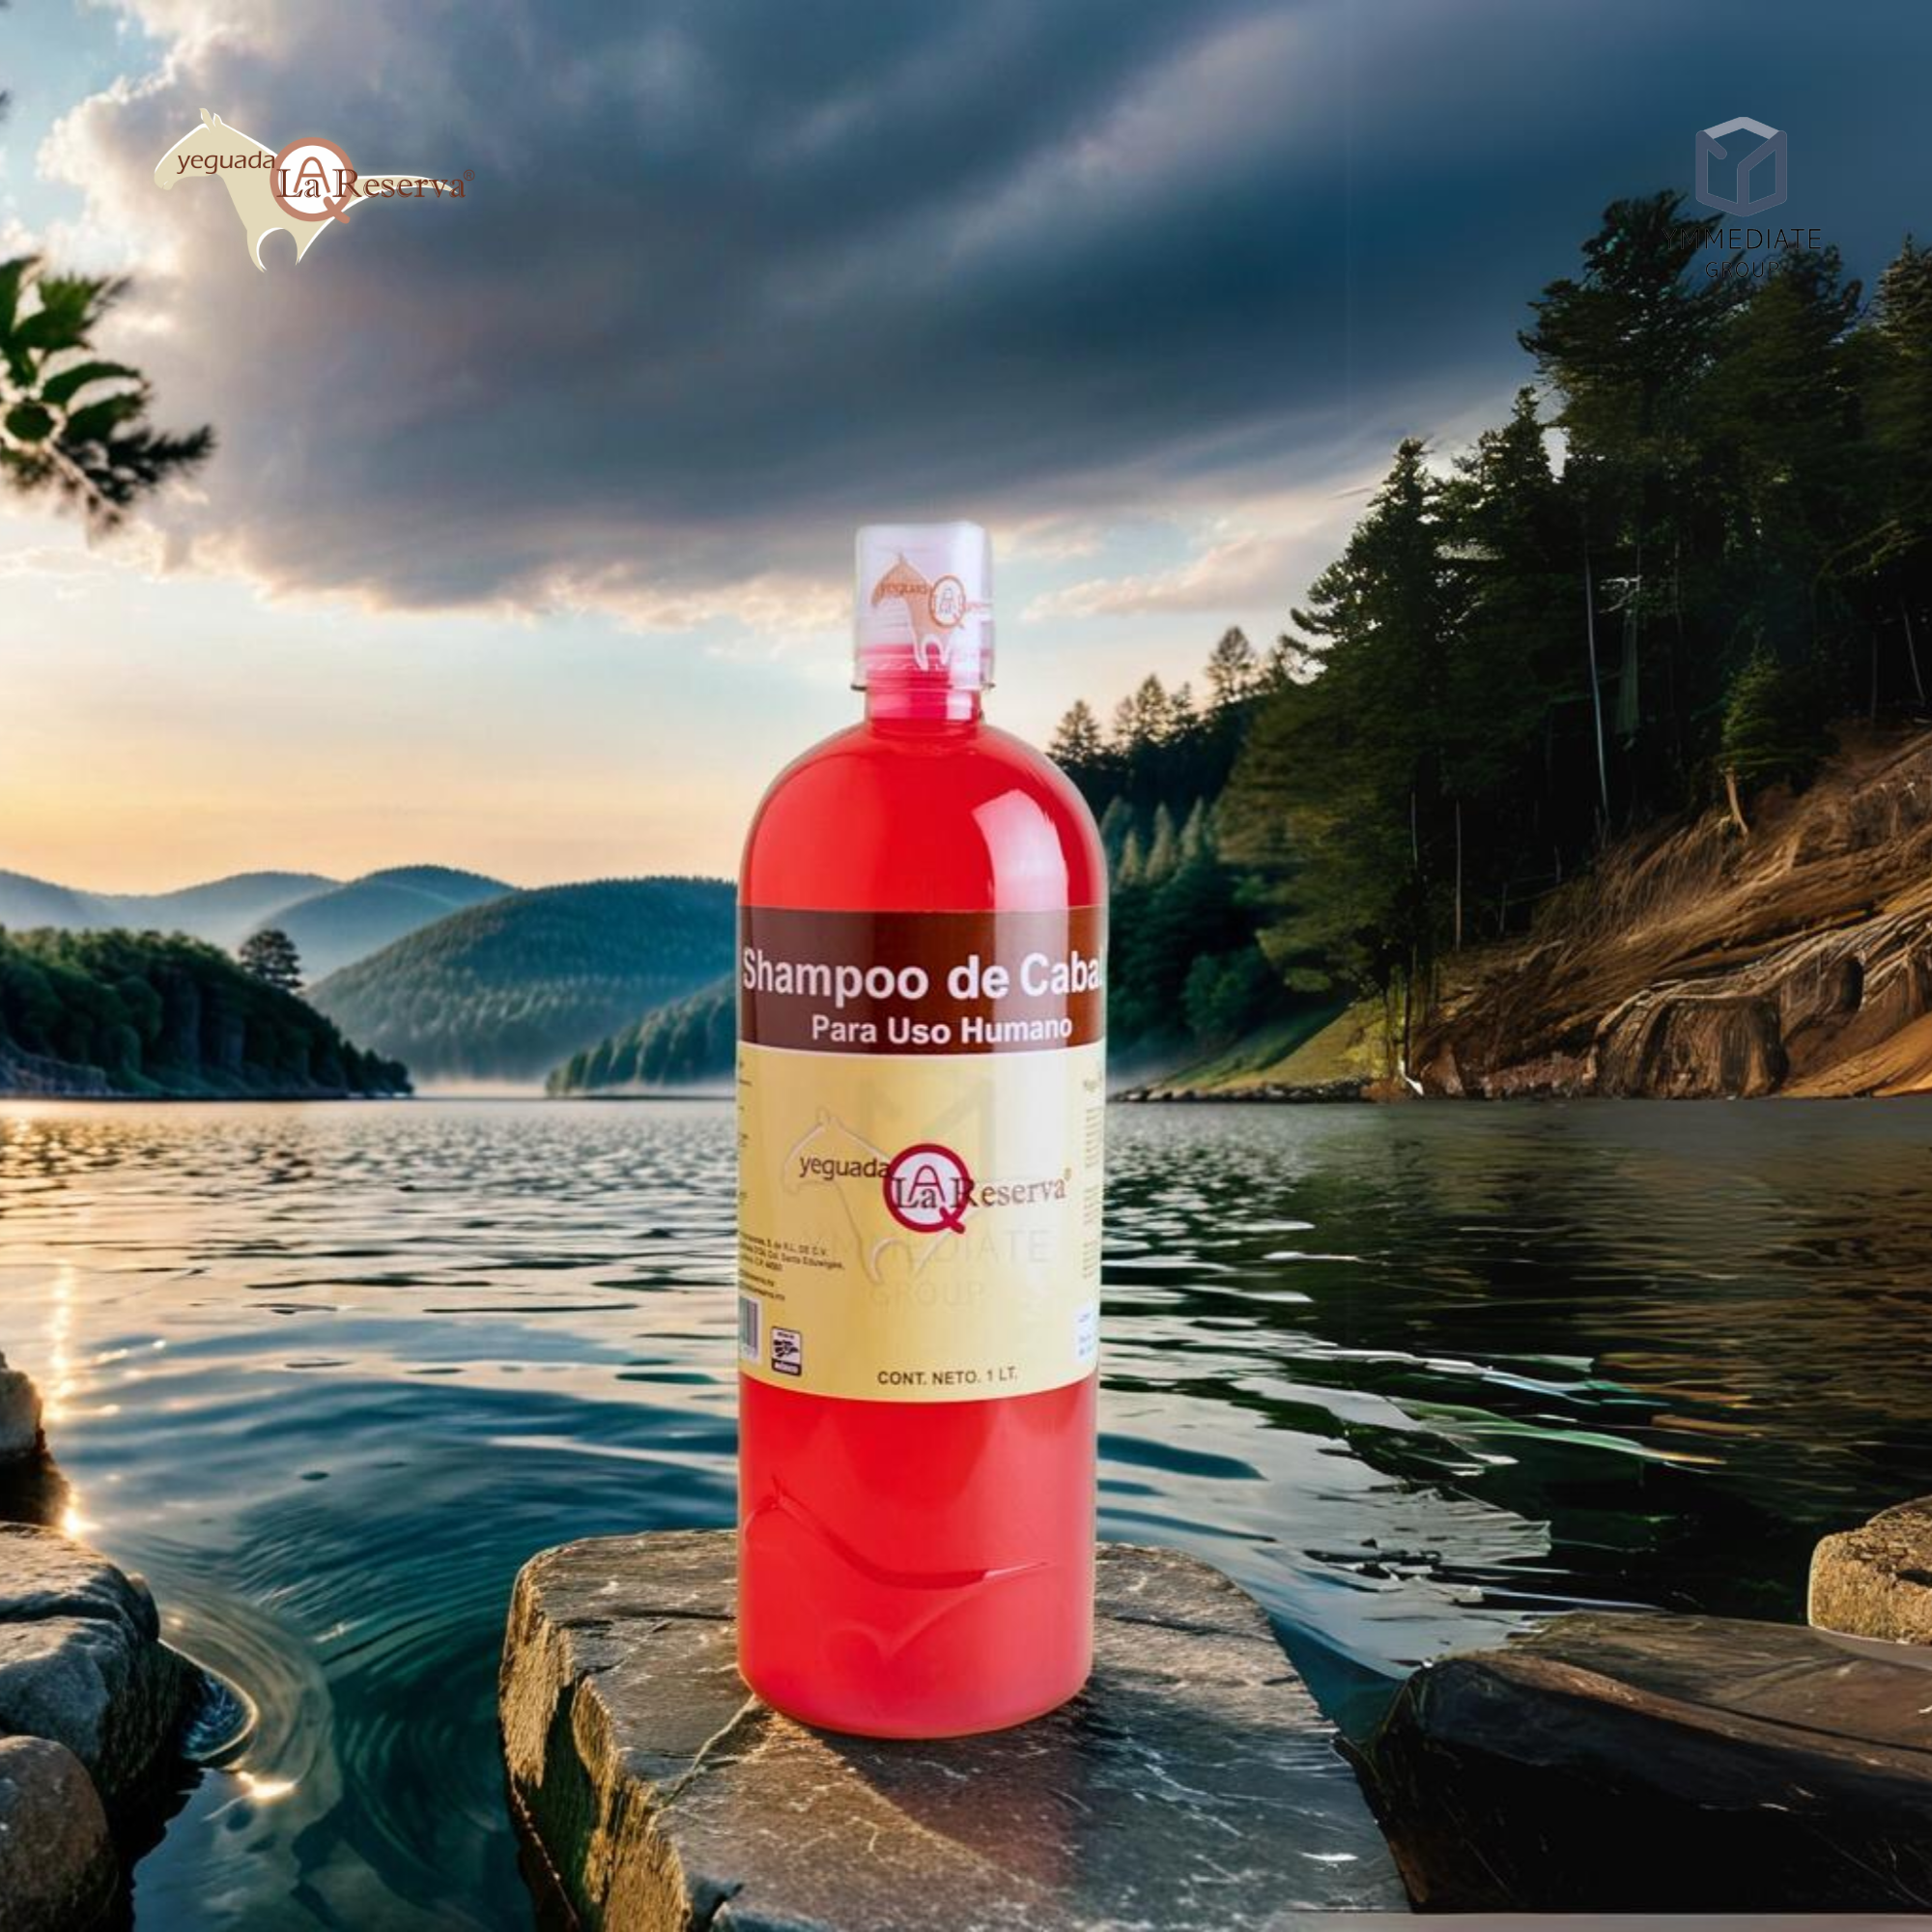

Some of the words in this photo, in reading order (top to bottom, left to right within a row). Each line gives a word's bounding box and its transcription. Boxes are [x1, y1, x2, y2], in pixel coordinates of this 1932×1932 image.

[742, 948, 929, 1009] Shampoo
[948, 954, 1009, 999] de
[811, 1014, 876, 1042] Para
[888, 1016, 952, 1044] Uso
[961, 1014, 1073, 1043] Humano
[800, 1156, 889, 1179] yeguada
[893, 1177, 938, 1208] La
[877, 1370, 927, 1386] CONT.
[932, 1370, 981, 1385] NETO.
[986, 1370, 994, 1382] 1
[999, 1366, 1018, 1381] LT.
